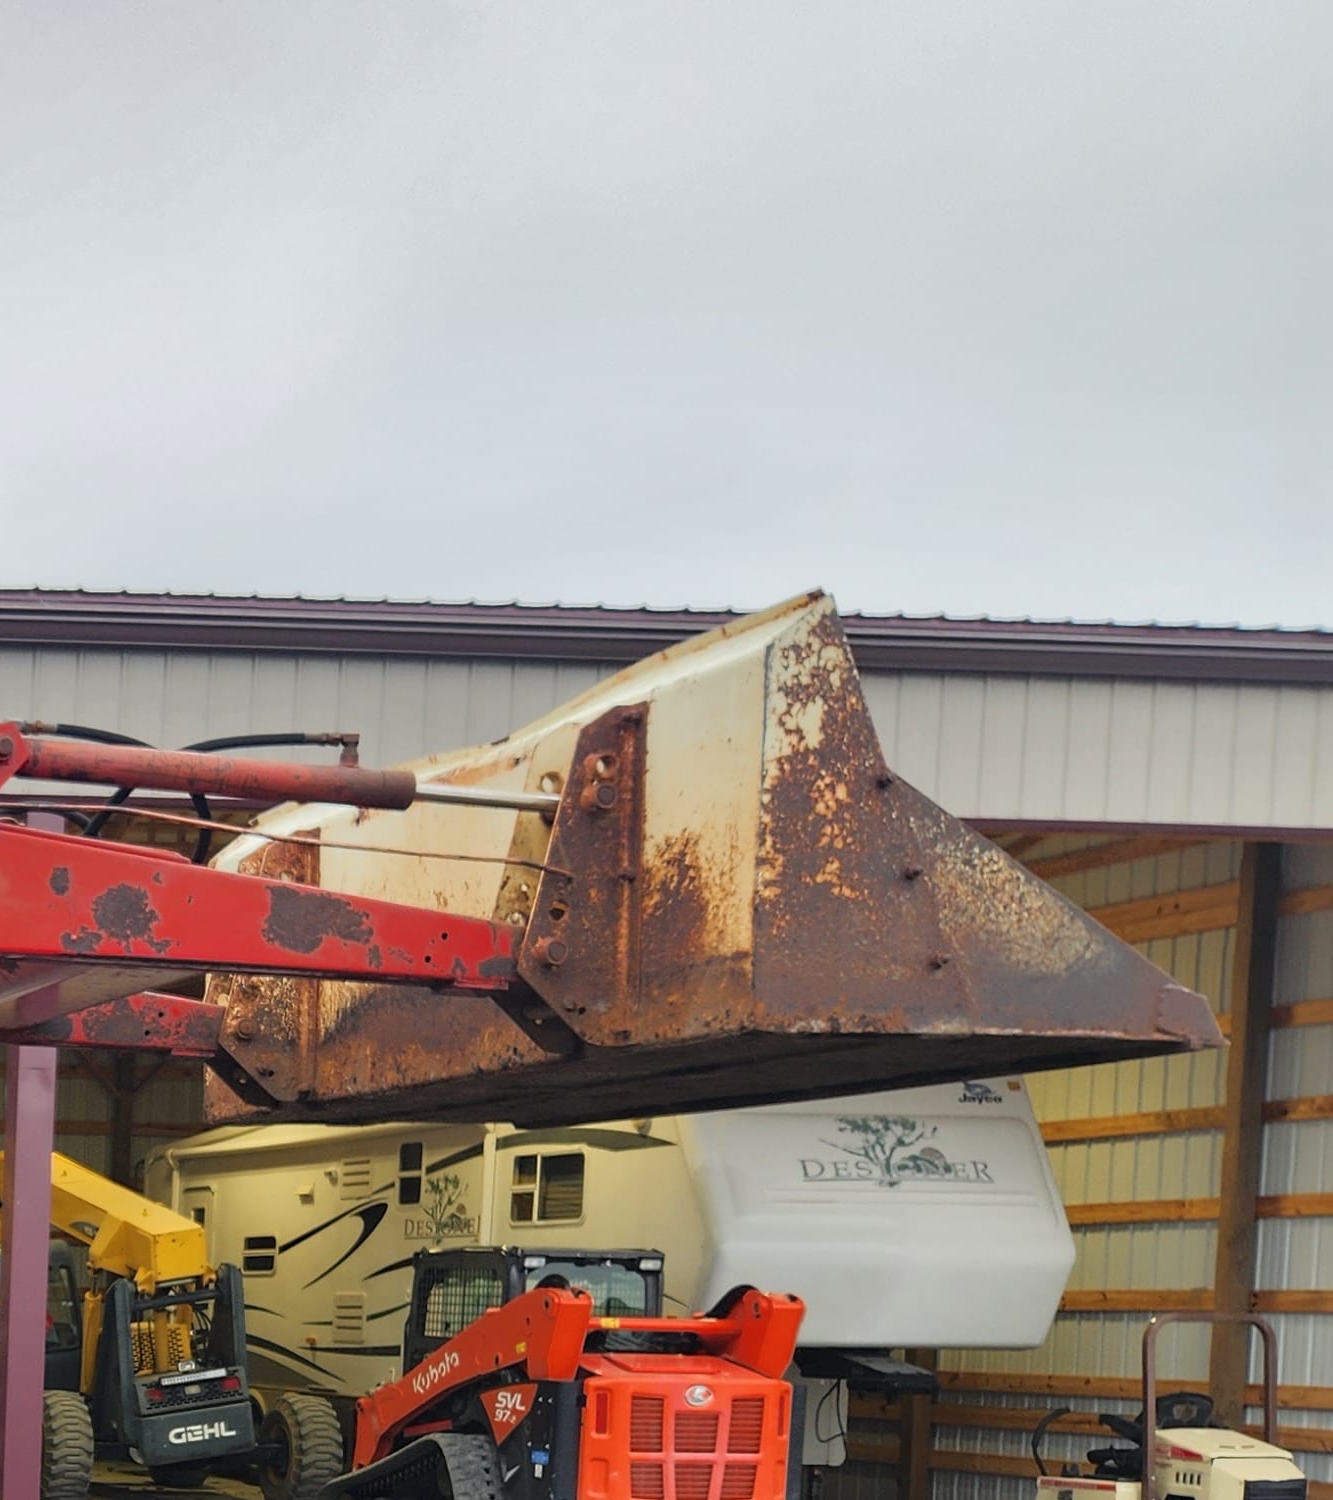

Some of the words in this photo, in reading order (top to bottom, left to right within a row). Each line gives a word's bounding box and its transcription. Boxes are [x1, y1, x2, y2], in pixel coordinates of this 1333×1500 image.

[412, 1352, 460, 1394] Kubota
[495, 1391, 526, 1411] SVL
[168, 1421, 237, 1445] GEHL
